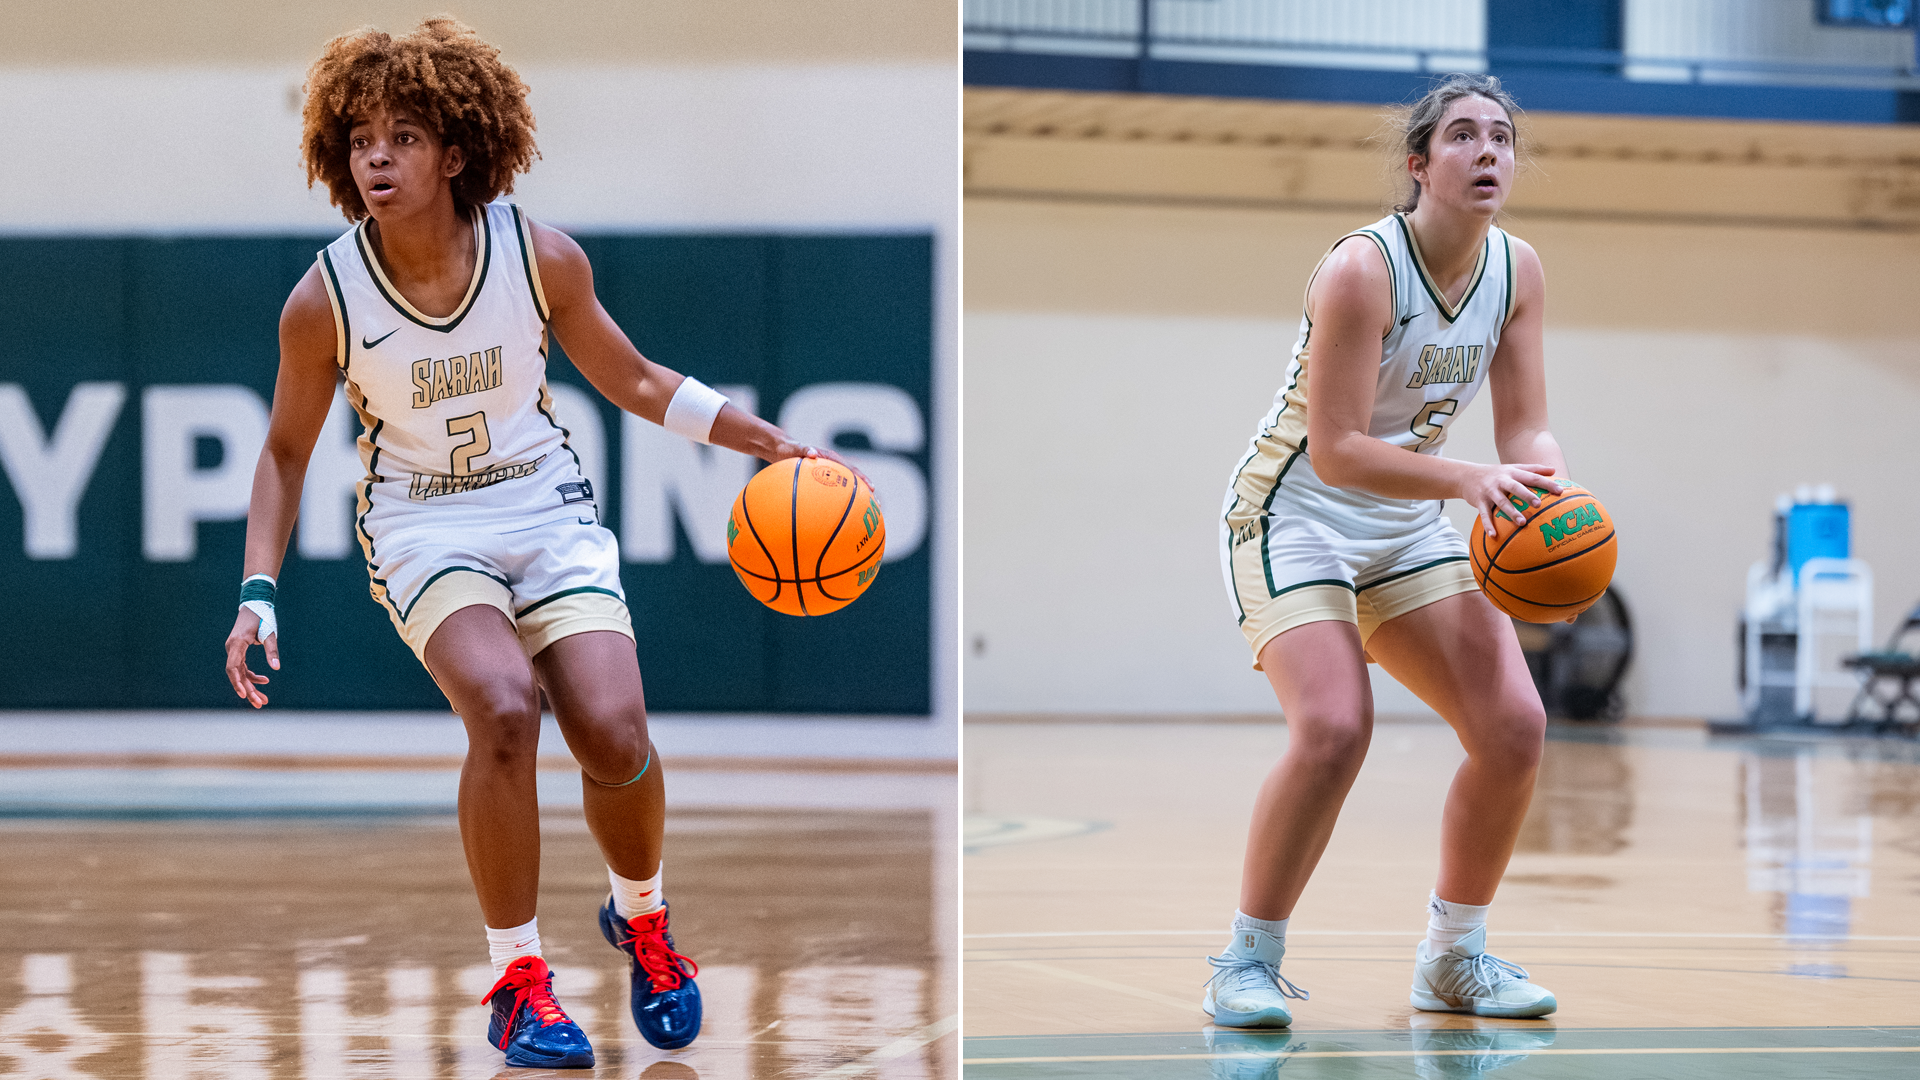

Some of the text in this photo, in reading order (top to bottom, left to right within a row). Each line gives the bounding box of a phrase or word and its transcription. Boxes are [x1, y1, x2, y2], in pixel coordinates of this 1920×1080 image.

[411, 345, 503, 409] SARAH
[1406, 344, 1484, 389] SARAH
[446, 410, 494, 477] 2
[1401, 398, 1459, 453] 5
[1539, 503, 1603, 547] NCAA
[1548, 536, 1578, 553] OFFICIAL
[1577, 527, 1594, 539] GAME
